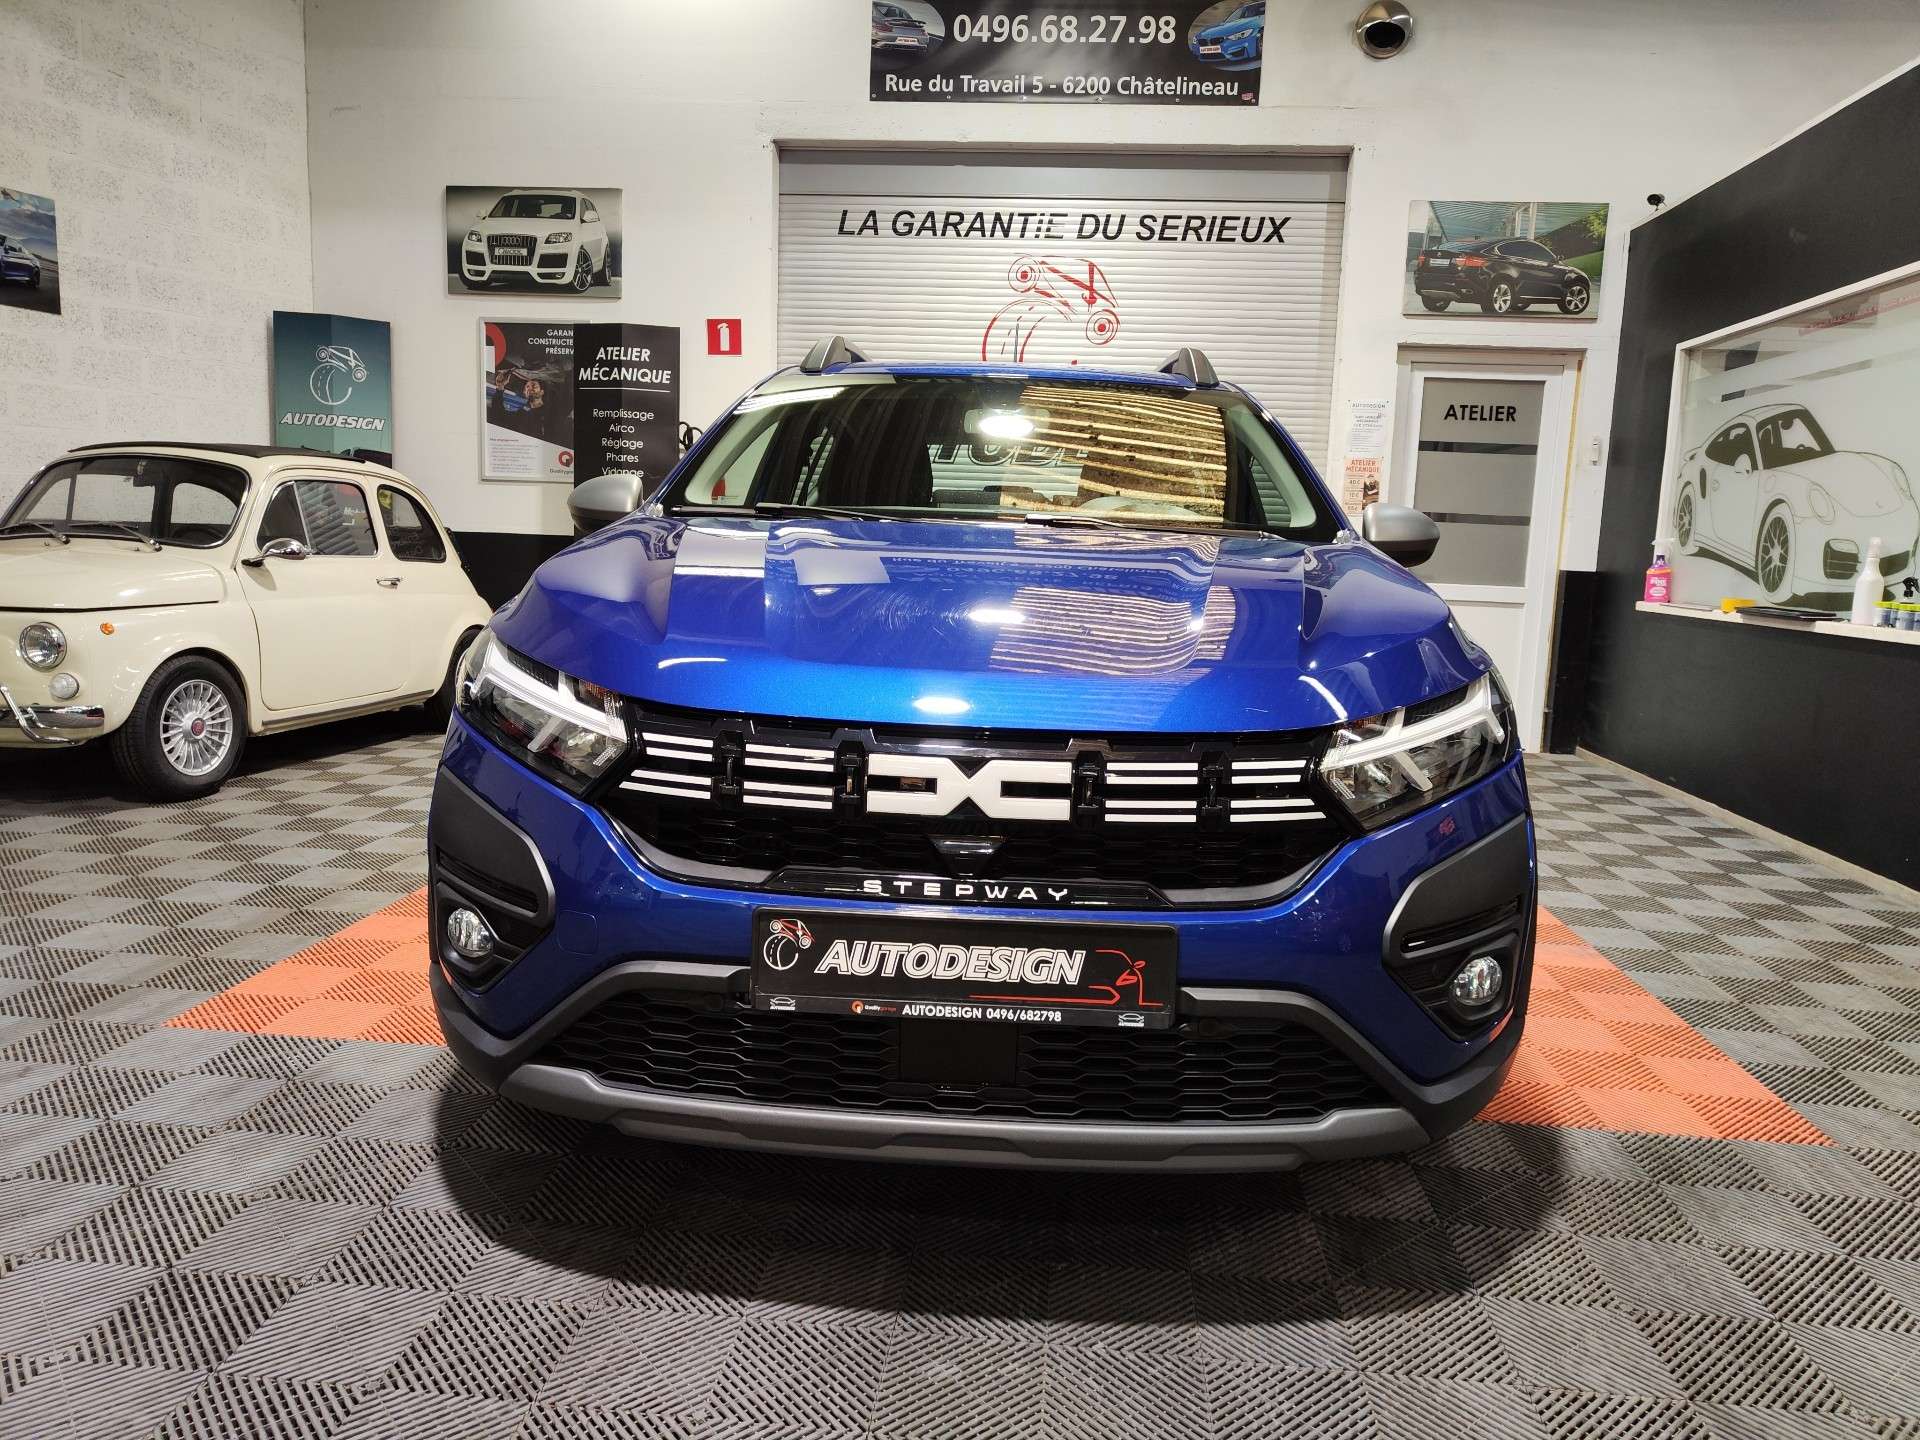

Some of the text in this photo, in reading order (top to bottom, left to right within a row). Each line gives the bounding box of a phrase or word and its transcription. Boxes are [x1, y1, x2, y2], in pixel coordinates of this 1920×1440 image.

[953, 14, 1176, 44] 0496.68.27.98
[885, 74, 923, 92] Rue
[928, 74, 954, 93] du
[959, 73, 1026, 96] Travail
[1031, 75, 1044, 96] 5
[1061, 75, 1112, 97] 6200
[1115, 75, 1240, 98] Châtelineau
[838, 209, 879, 236] LA
[1076, 214, 1127, 241] DU
[1135, 215, 1292, 243] SERIEUX
[527, 337, 574, 346] CONSTRUCTE
[546, 329, 574, 337] GARAN
[595, 346, 651, 362] ATELIER
[578, 363, 672, 384] MÉCANIQUE
[279, 412, 385, 431] AUTODESIGN
[592, 408, 655, 421] Remplissage
[1443, 404, 1517, 422] ATELIER
[608, 422, 636, 434] Airco
[601, 438, 644, 449] Réglage
[606, 452, 639, 463] Phares
[862, 879, 1069, 901] STEPWAY
[814, 939, 1086, 986] AUTODESIGN
[902, 1004, 982, 1019] AUTODESIGN
[986, 1007, 1062, 1022] 0496/682798
